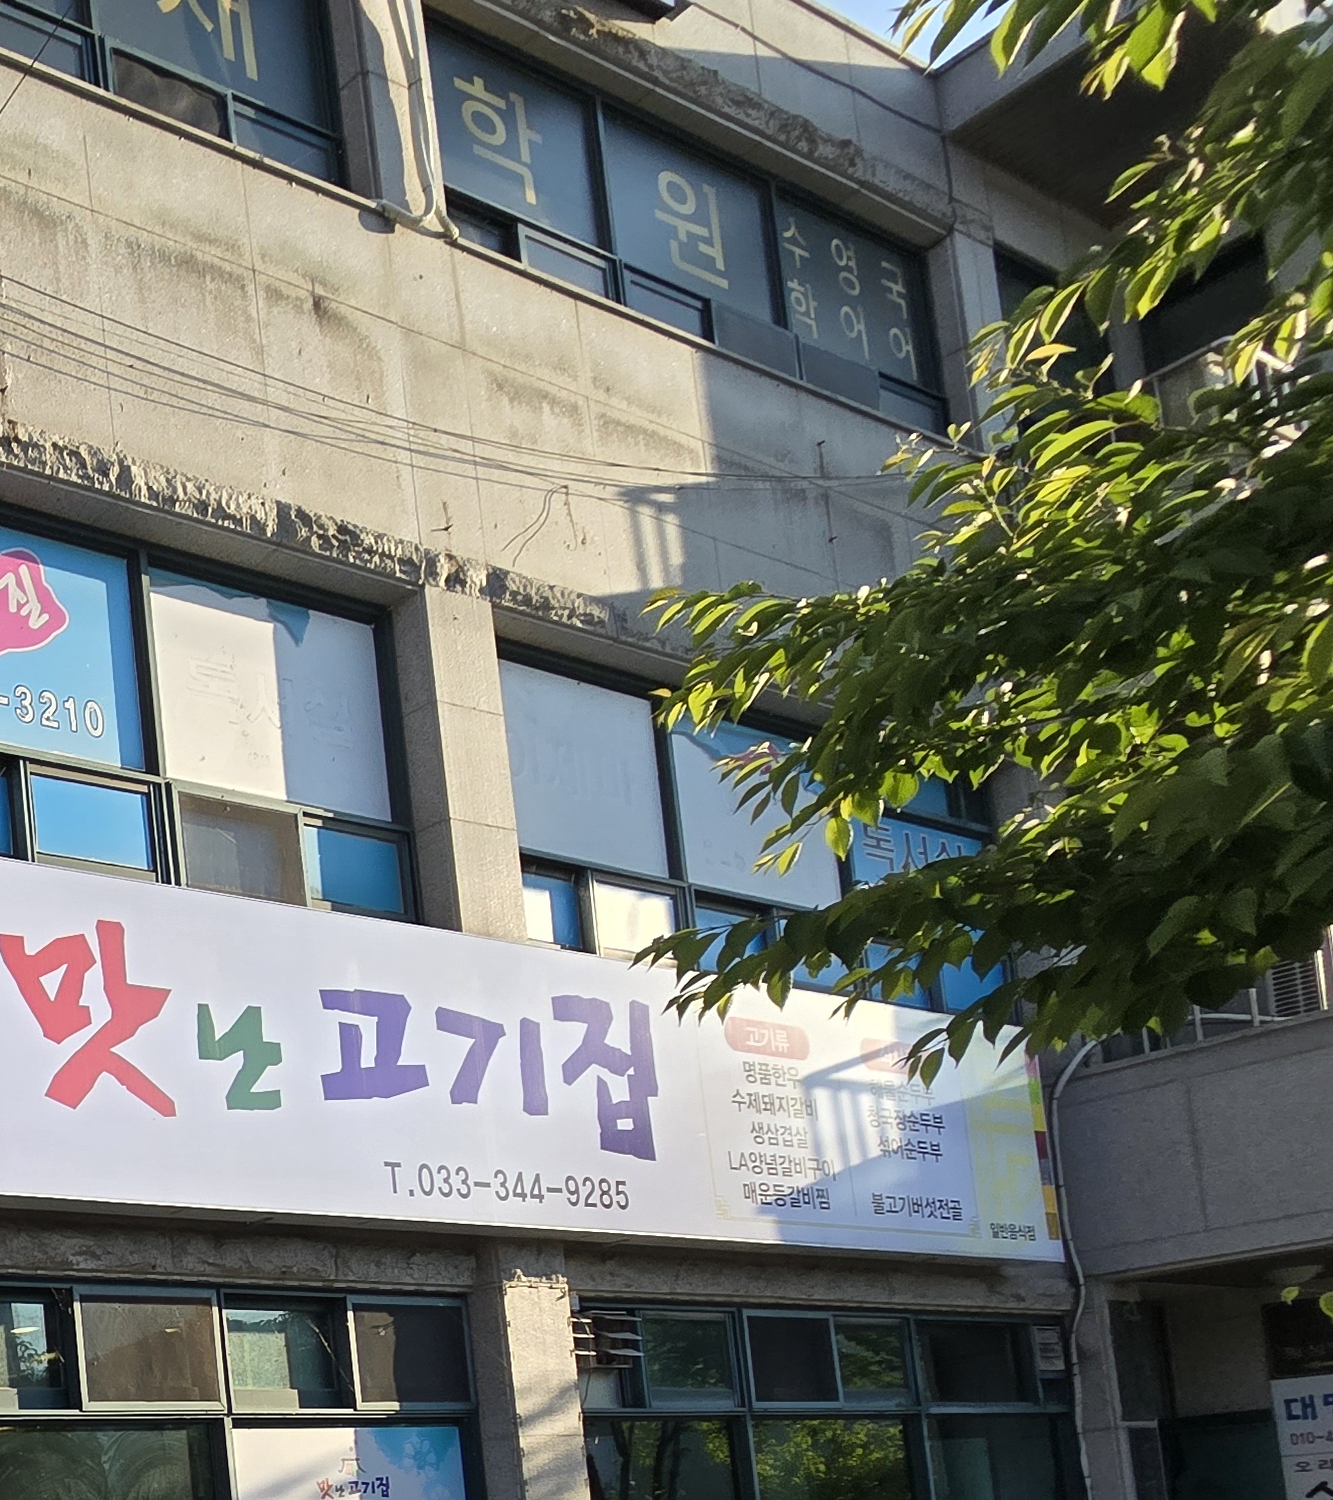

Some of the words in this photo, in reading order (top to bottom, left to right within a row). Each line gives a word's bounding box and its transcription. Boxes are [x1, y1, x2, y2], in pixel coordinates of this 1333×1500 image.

[783, 217, 819, 339] 수학
[831, 238, 869, 360] 영어
[881, 261, 917, 381] 국어
[744, 1026, 791, 1053] 고기류
[742, 1060, 801, 1090] 명품한우
[731, 1088, 819, 1121] 수제돼지갈비
[750, 1121, 808, 1149] 생삼겹살
[867, 1107, 946, 1136] 청국장순두부
[728, 1151, 837, 1182] LA양념갈비구이
[383, 1160, 630, 1211] T.033-344-9285
[742, 1181, 831, 1211] 매운등갈비찜
[871, 1192, 963, 1222] 불고기버섯전골
